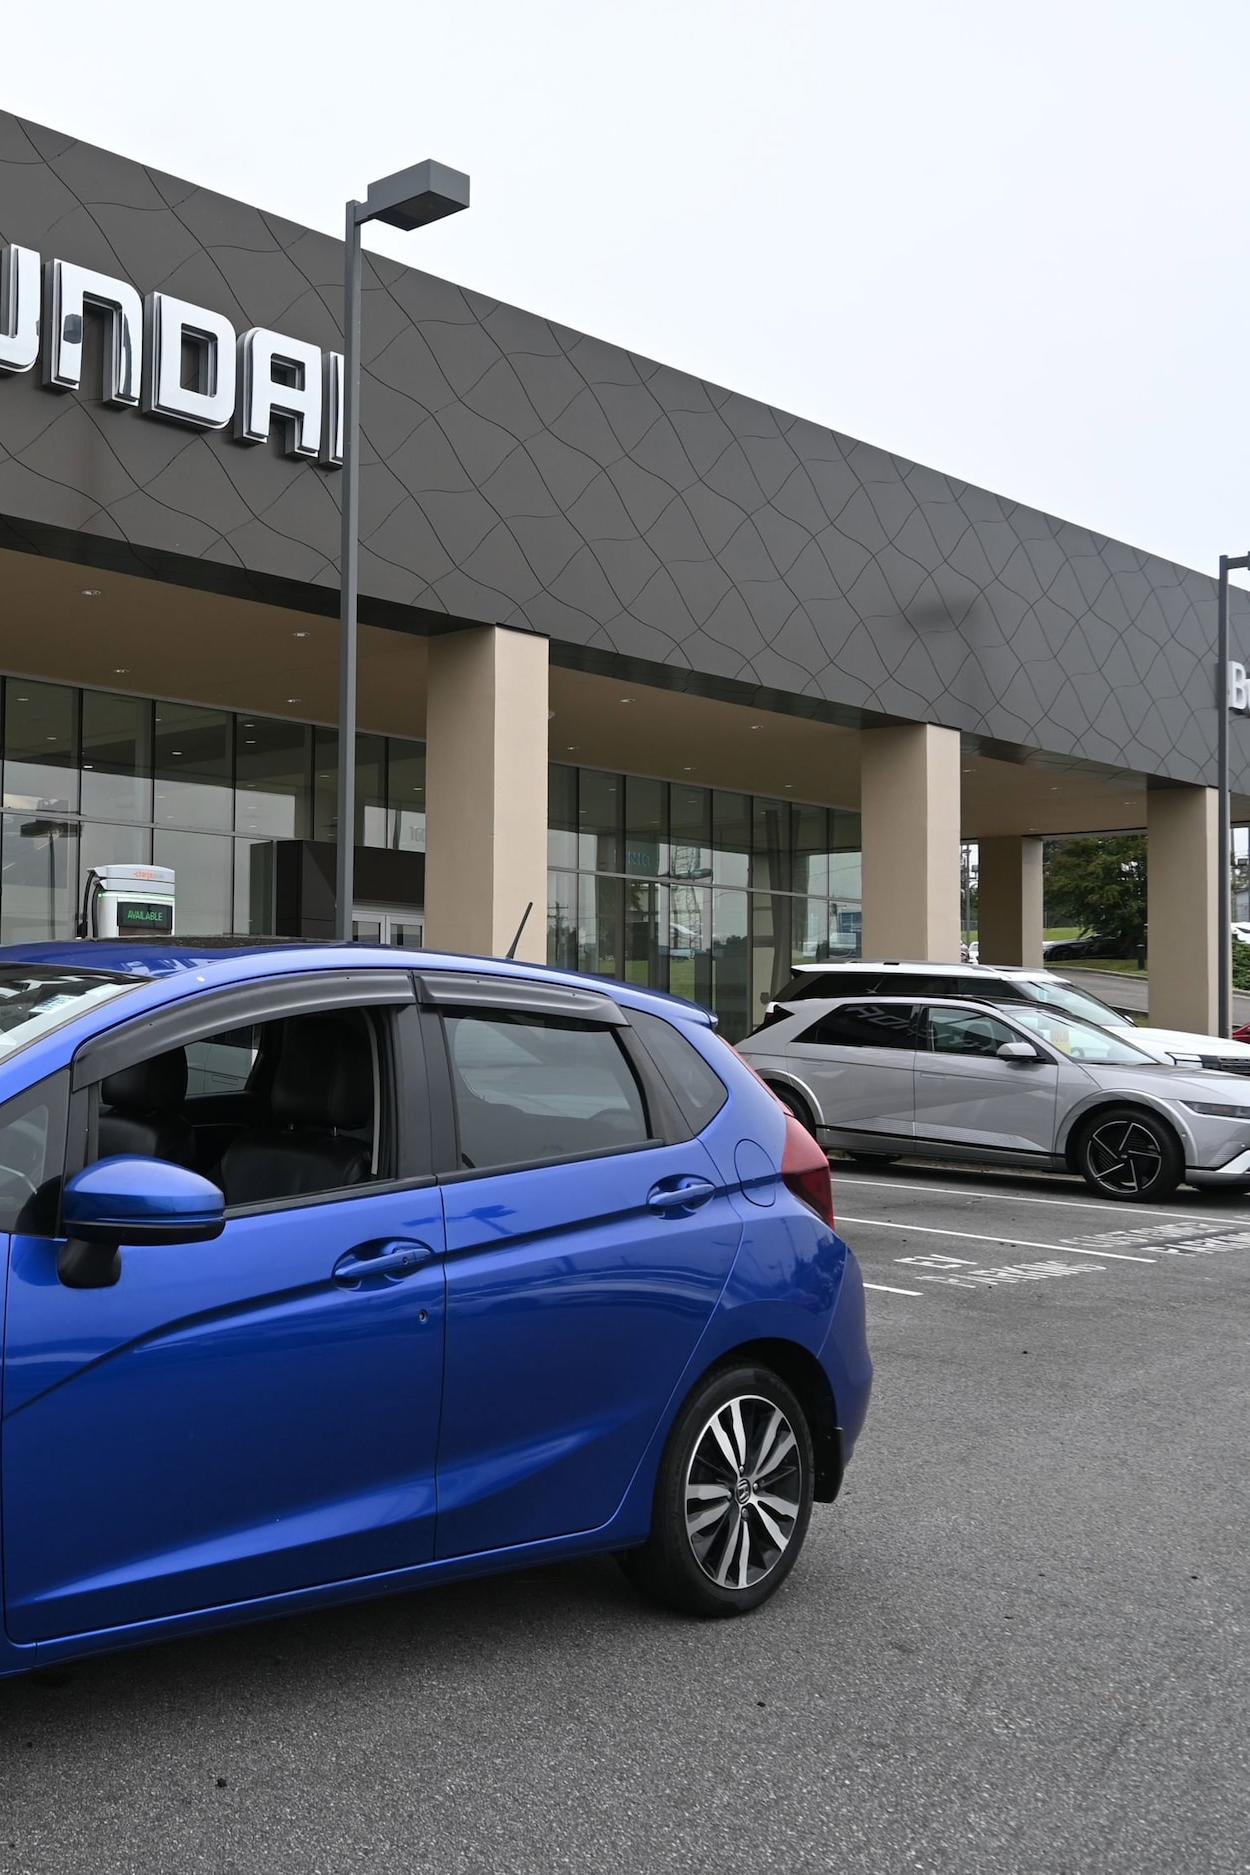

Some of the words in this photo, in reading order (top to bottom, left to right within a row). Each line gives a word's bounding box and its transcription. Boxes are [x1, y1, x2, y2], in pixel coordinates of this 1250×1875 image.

[1226, 660, 1250, 711] B
[612, 848, 652, 868] INIQ
[127, 910, 164, 921] AVAILABLE
[893, 1253, 978, 1269] EV
[914, 1260, 1107, 1289] PARKING
